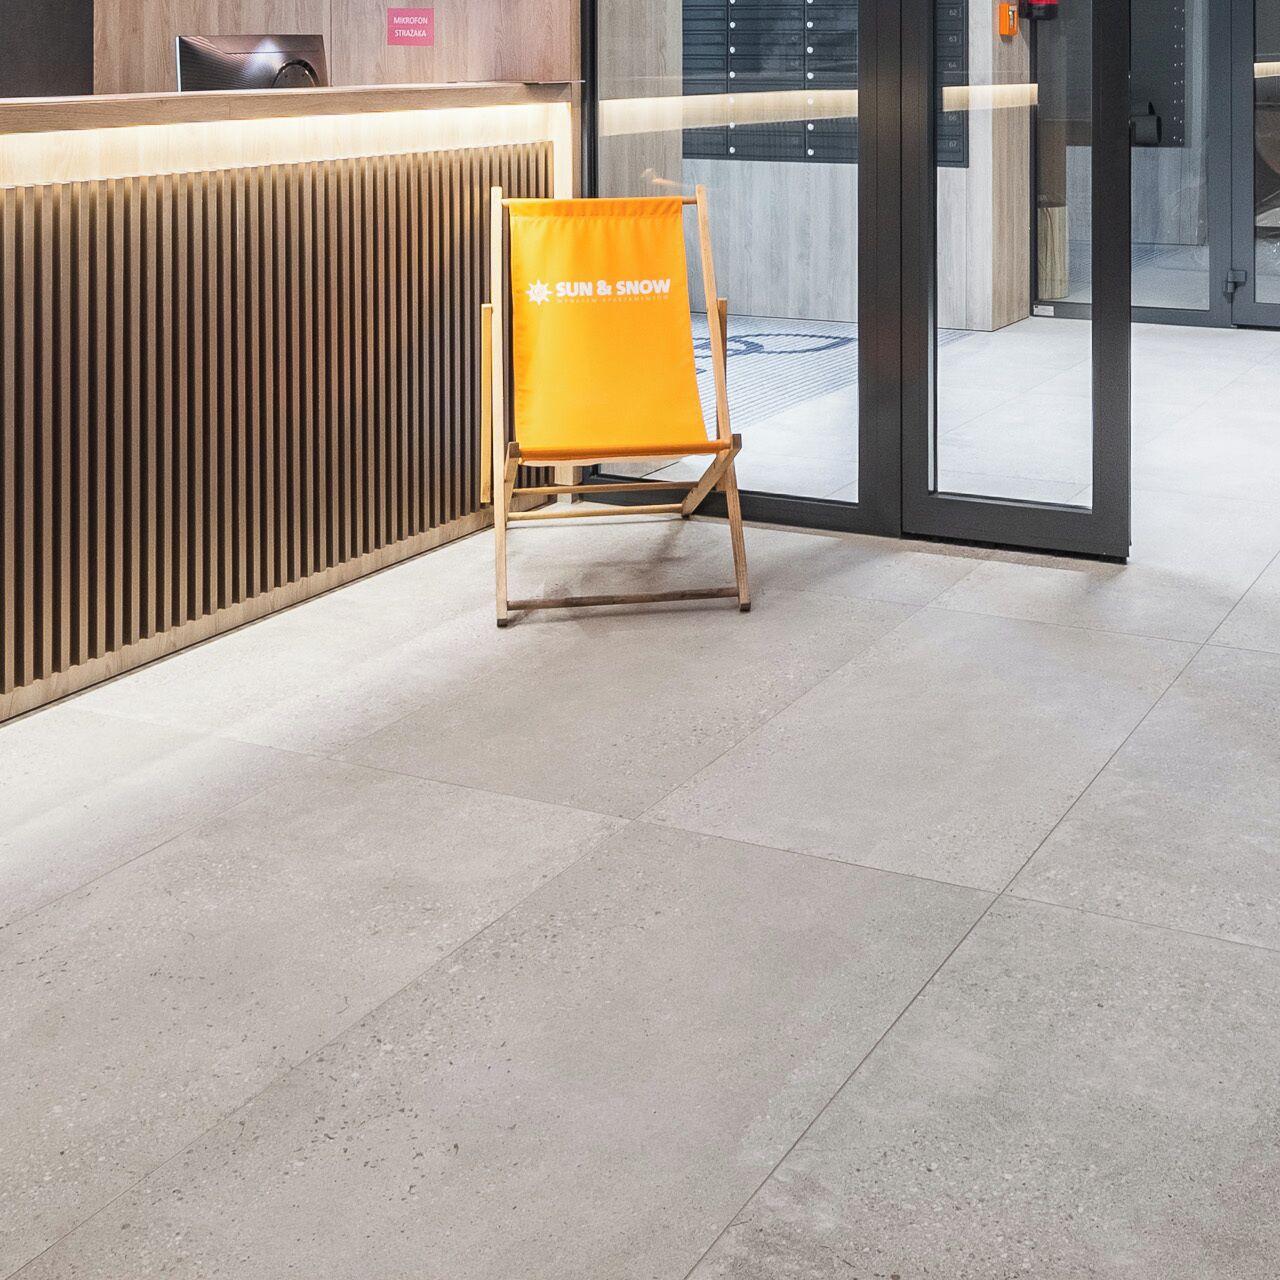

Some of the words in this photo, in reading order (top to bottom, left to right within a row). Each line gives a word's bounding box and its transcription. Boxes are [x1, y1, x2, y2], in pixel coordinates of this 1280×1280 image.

[393, 16, 428, 24] MIKROFON
[394, 28, 427, 38] STRAŻAKA
[555, 280, 593, 297] SUN
[596, 279, 613, 296] &
[615, 277, 671, 297] SNOW
